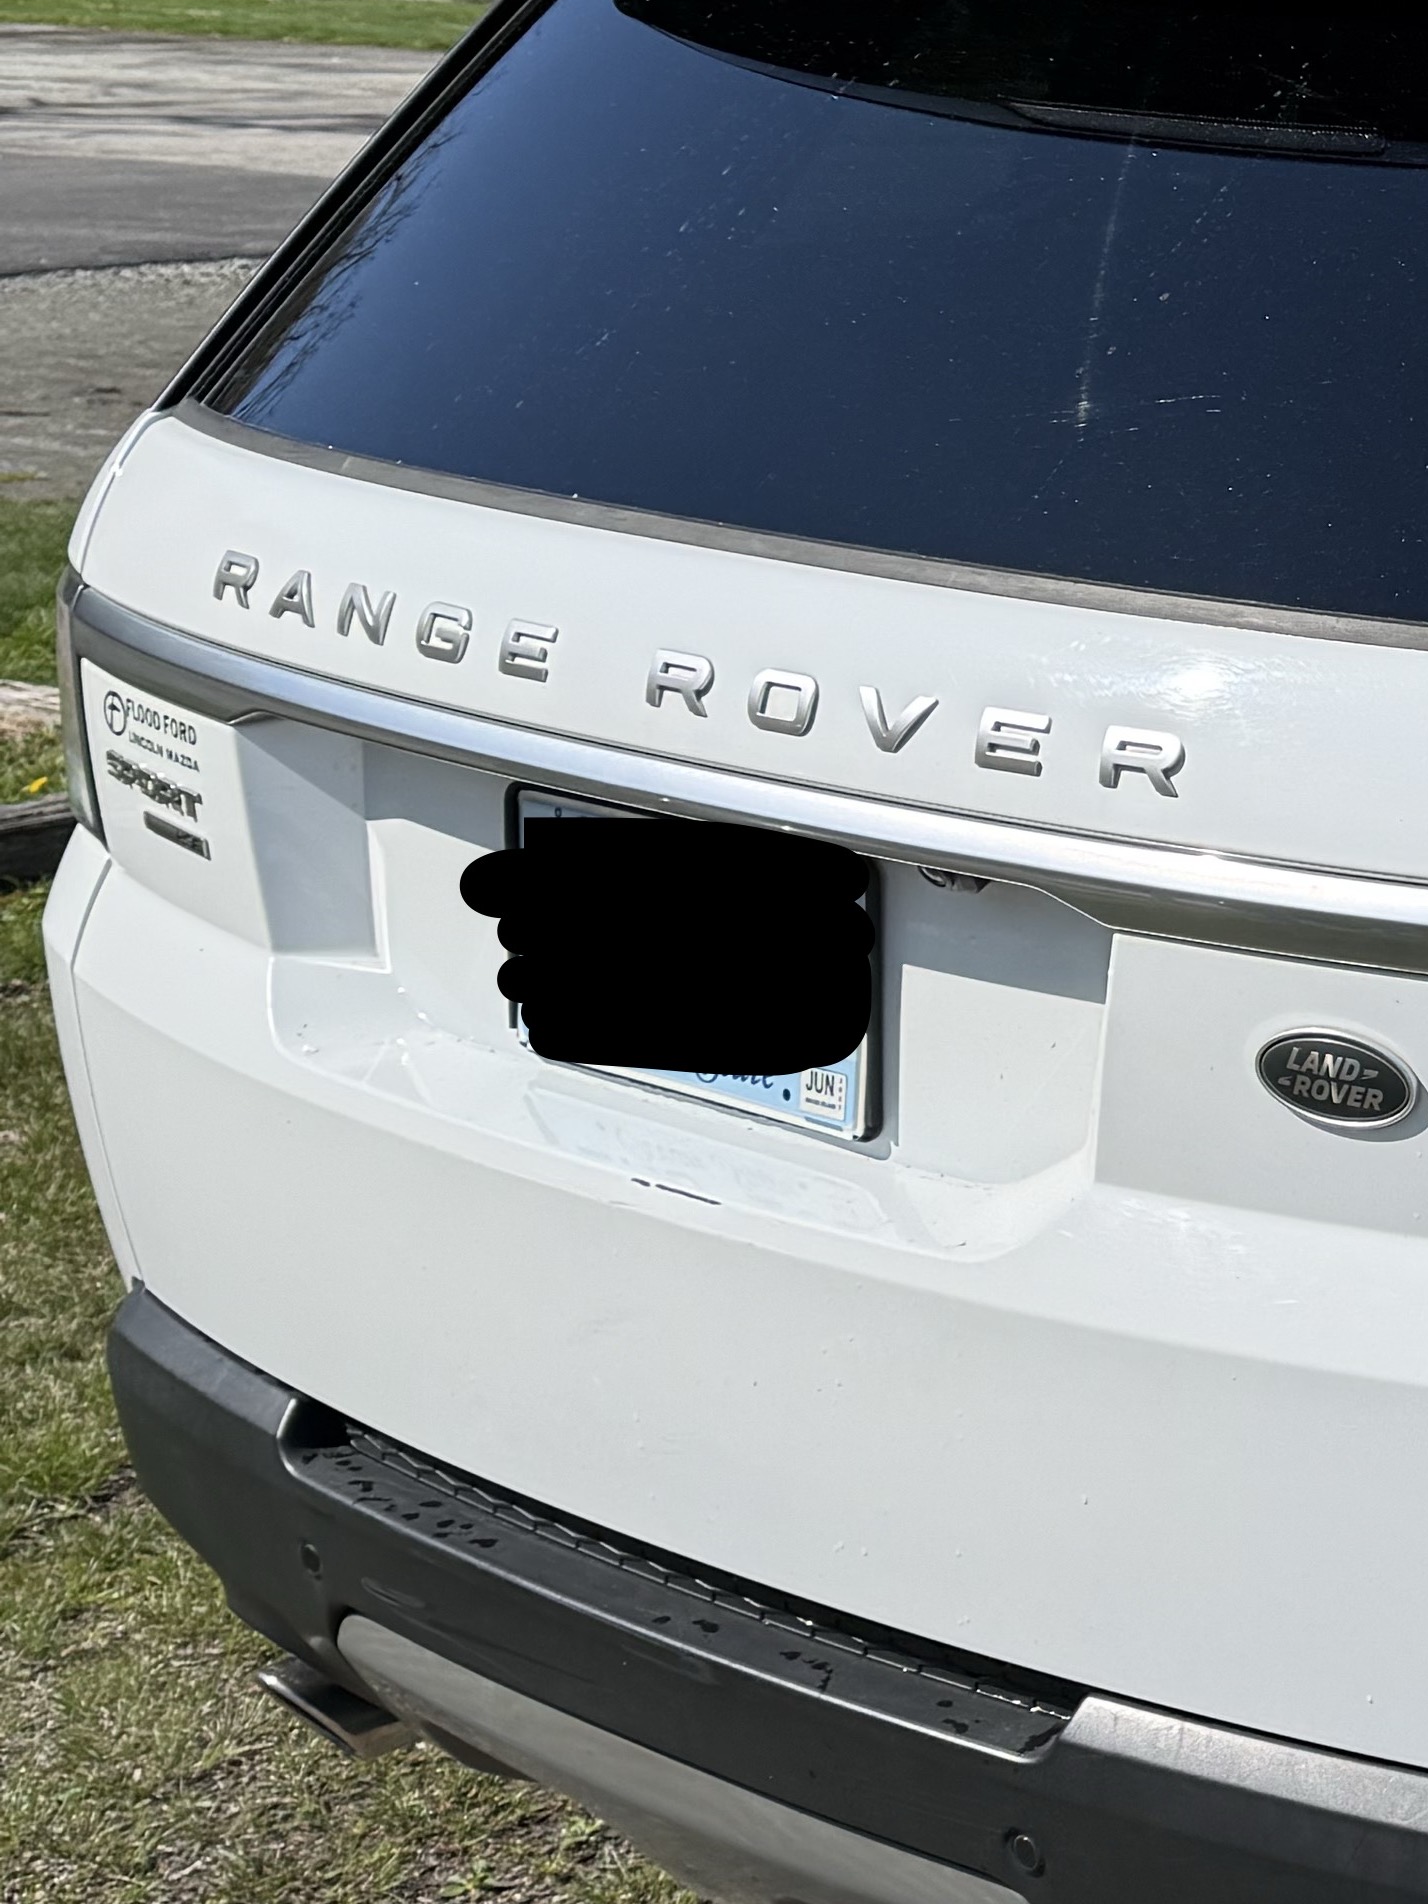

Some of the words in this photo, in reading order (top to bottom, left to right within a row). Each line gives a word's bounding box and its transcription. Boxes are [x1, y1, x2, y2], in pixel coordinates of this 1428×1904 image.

[211, 549, 560, 683] RANGE
[645, 648, 1186, 798] ROVER
[126, 698, 161, 731] FLOOD
[163, 715, 197, 746] FORD
[166, 748, 200, 772] MAZDA
[106, 749, 203, 823] SPORT
[1286, 1047, 1360, 1081] LAND
[805, 1070, 835, 1096] JUN
[1292, 1074, 1384, 1111] ROVER
